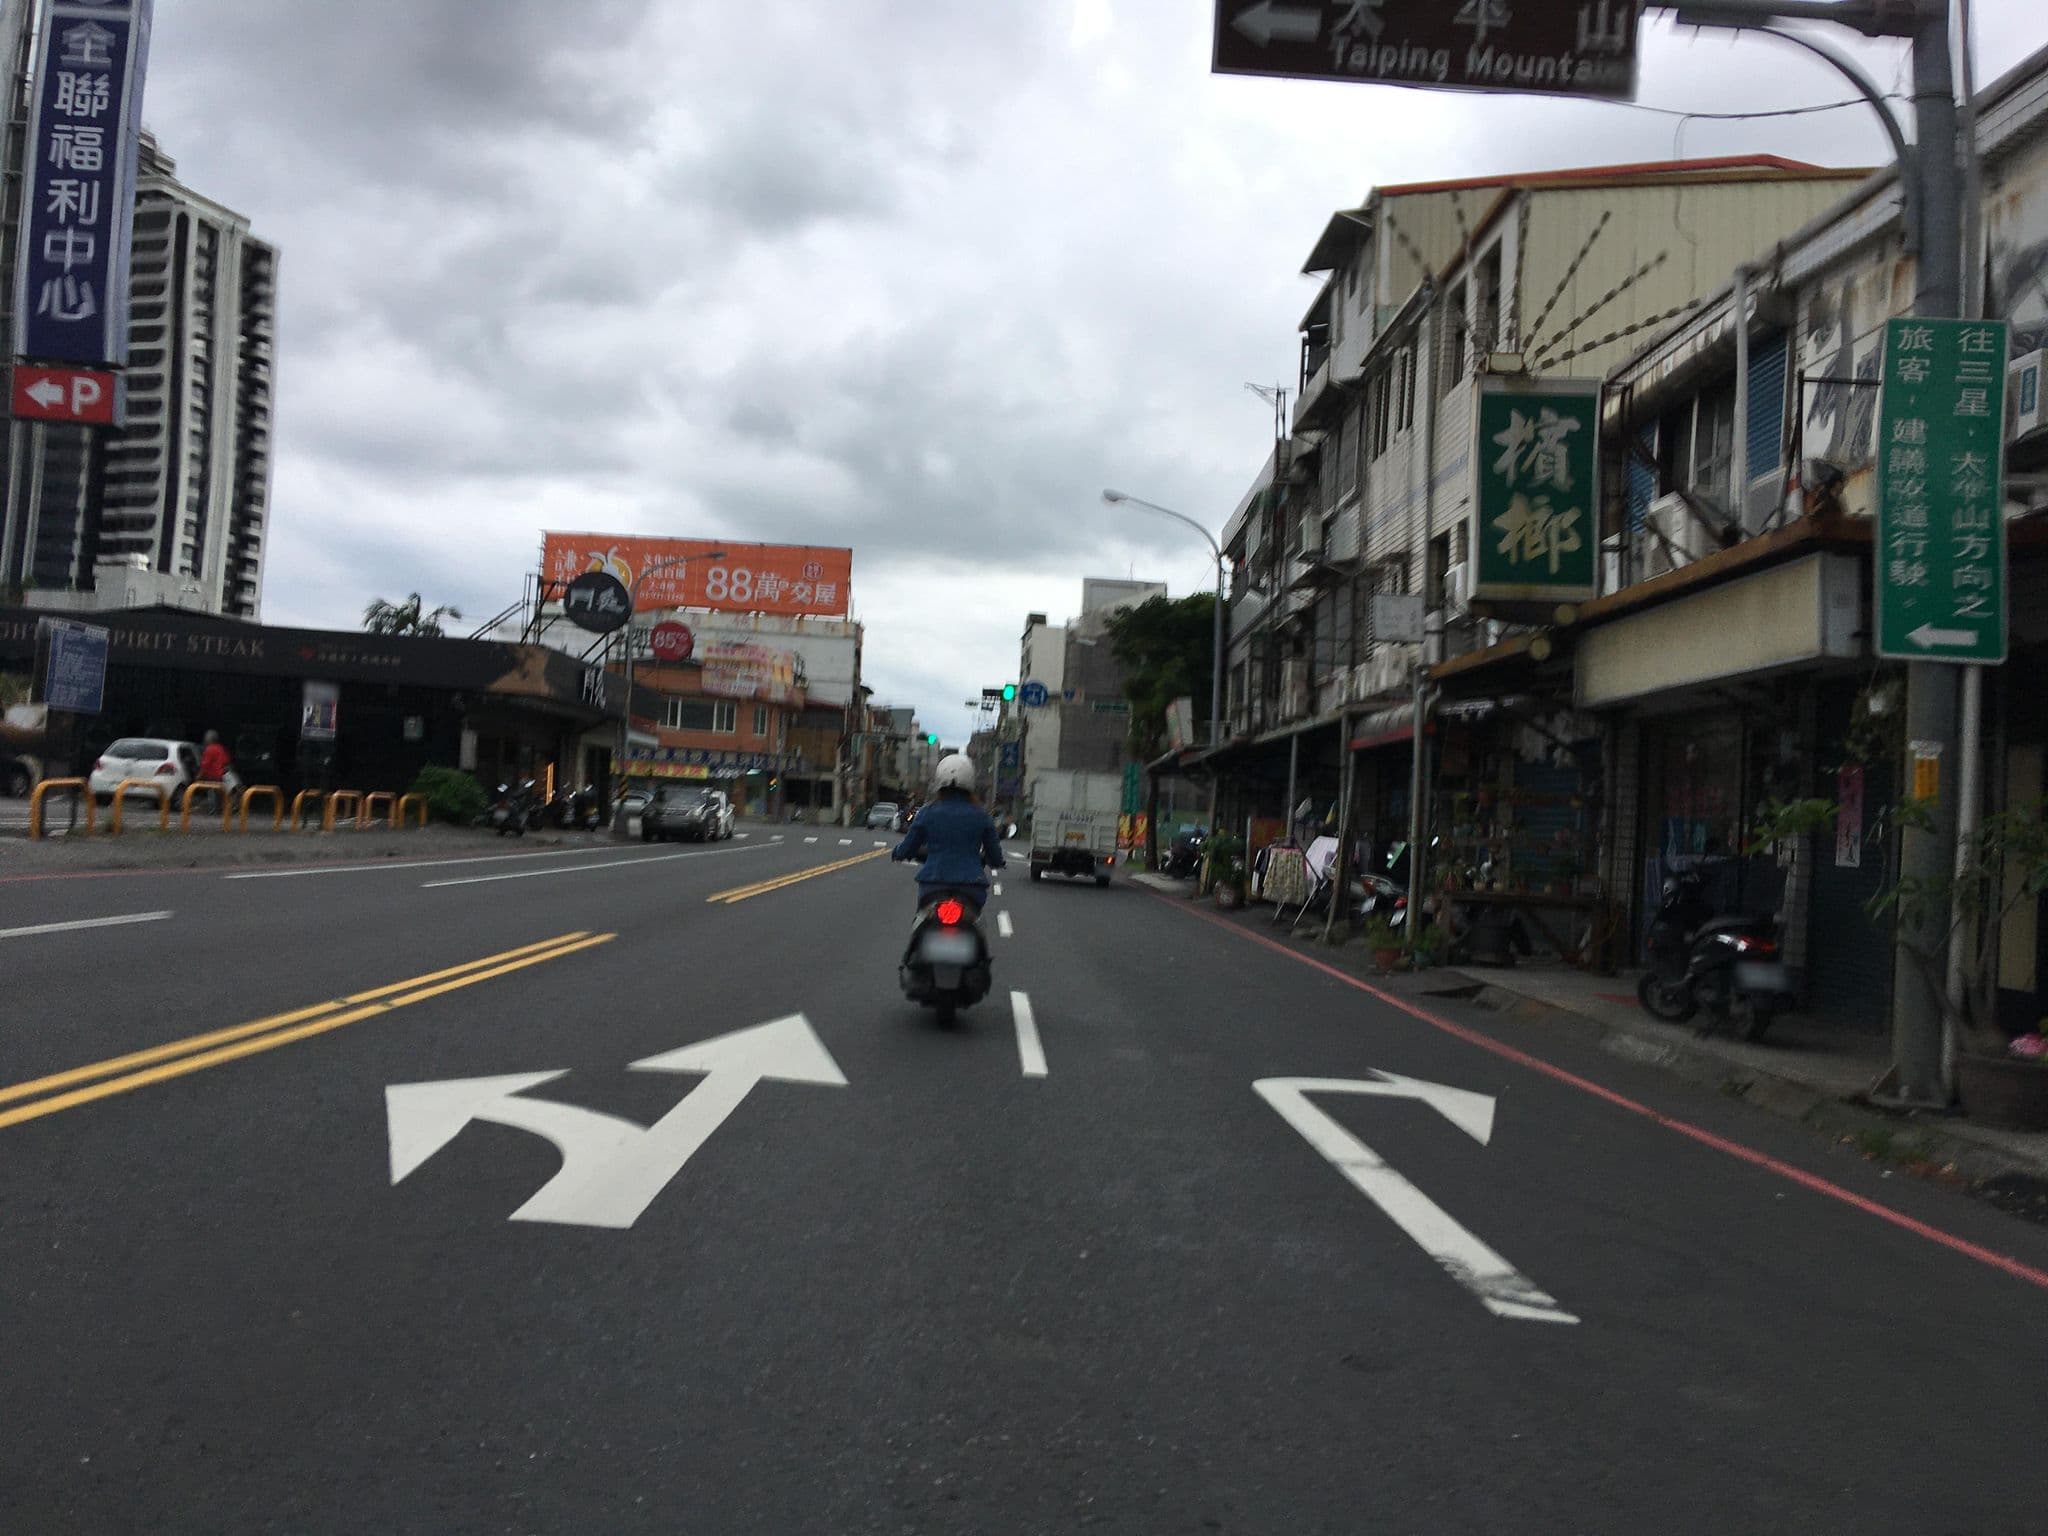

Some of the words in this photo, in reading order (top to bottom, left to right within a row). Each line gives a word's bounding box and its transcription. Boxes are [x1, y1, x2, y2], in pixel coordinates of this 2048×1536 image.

[1332, 38, 1449, 81] Taiping
[37, 21, 116, 322] 全聯福利中心
[71, 376, 101, 416] P
[1492, 406, 1582, 575] 檳榔
[112, 629, 177, 650] PIRIT
[187, 632, 264, 657] STEAK
